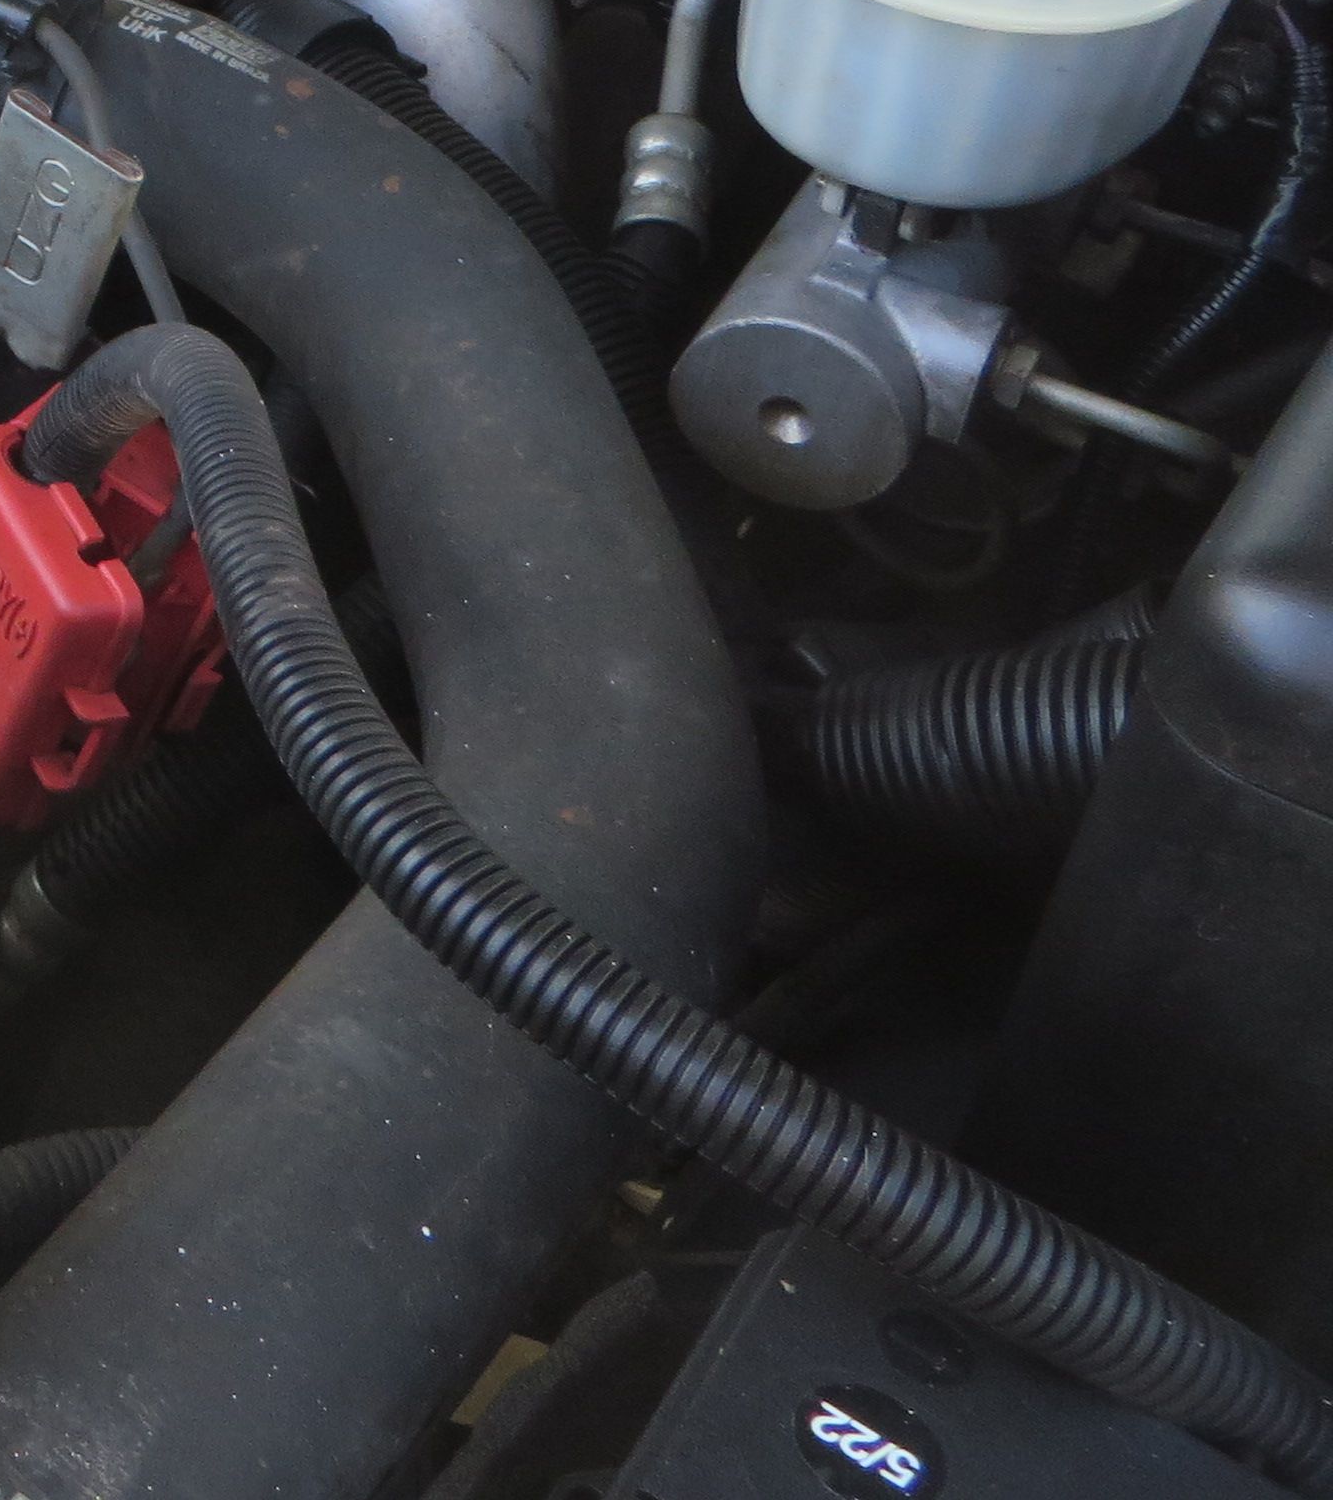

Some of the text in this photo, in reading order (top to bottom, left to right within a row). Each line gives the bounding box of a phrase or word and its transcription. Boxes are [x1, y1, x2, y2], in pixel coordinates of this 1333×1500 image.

[118, 15, 169, 43] UHK
[130, 6, 164, 23] UP
[175, 30, 213, 56] MADE
[211, 49, 229, 64] IN
[810, 1400, 921, 1490] 5/22
